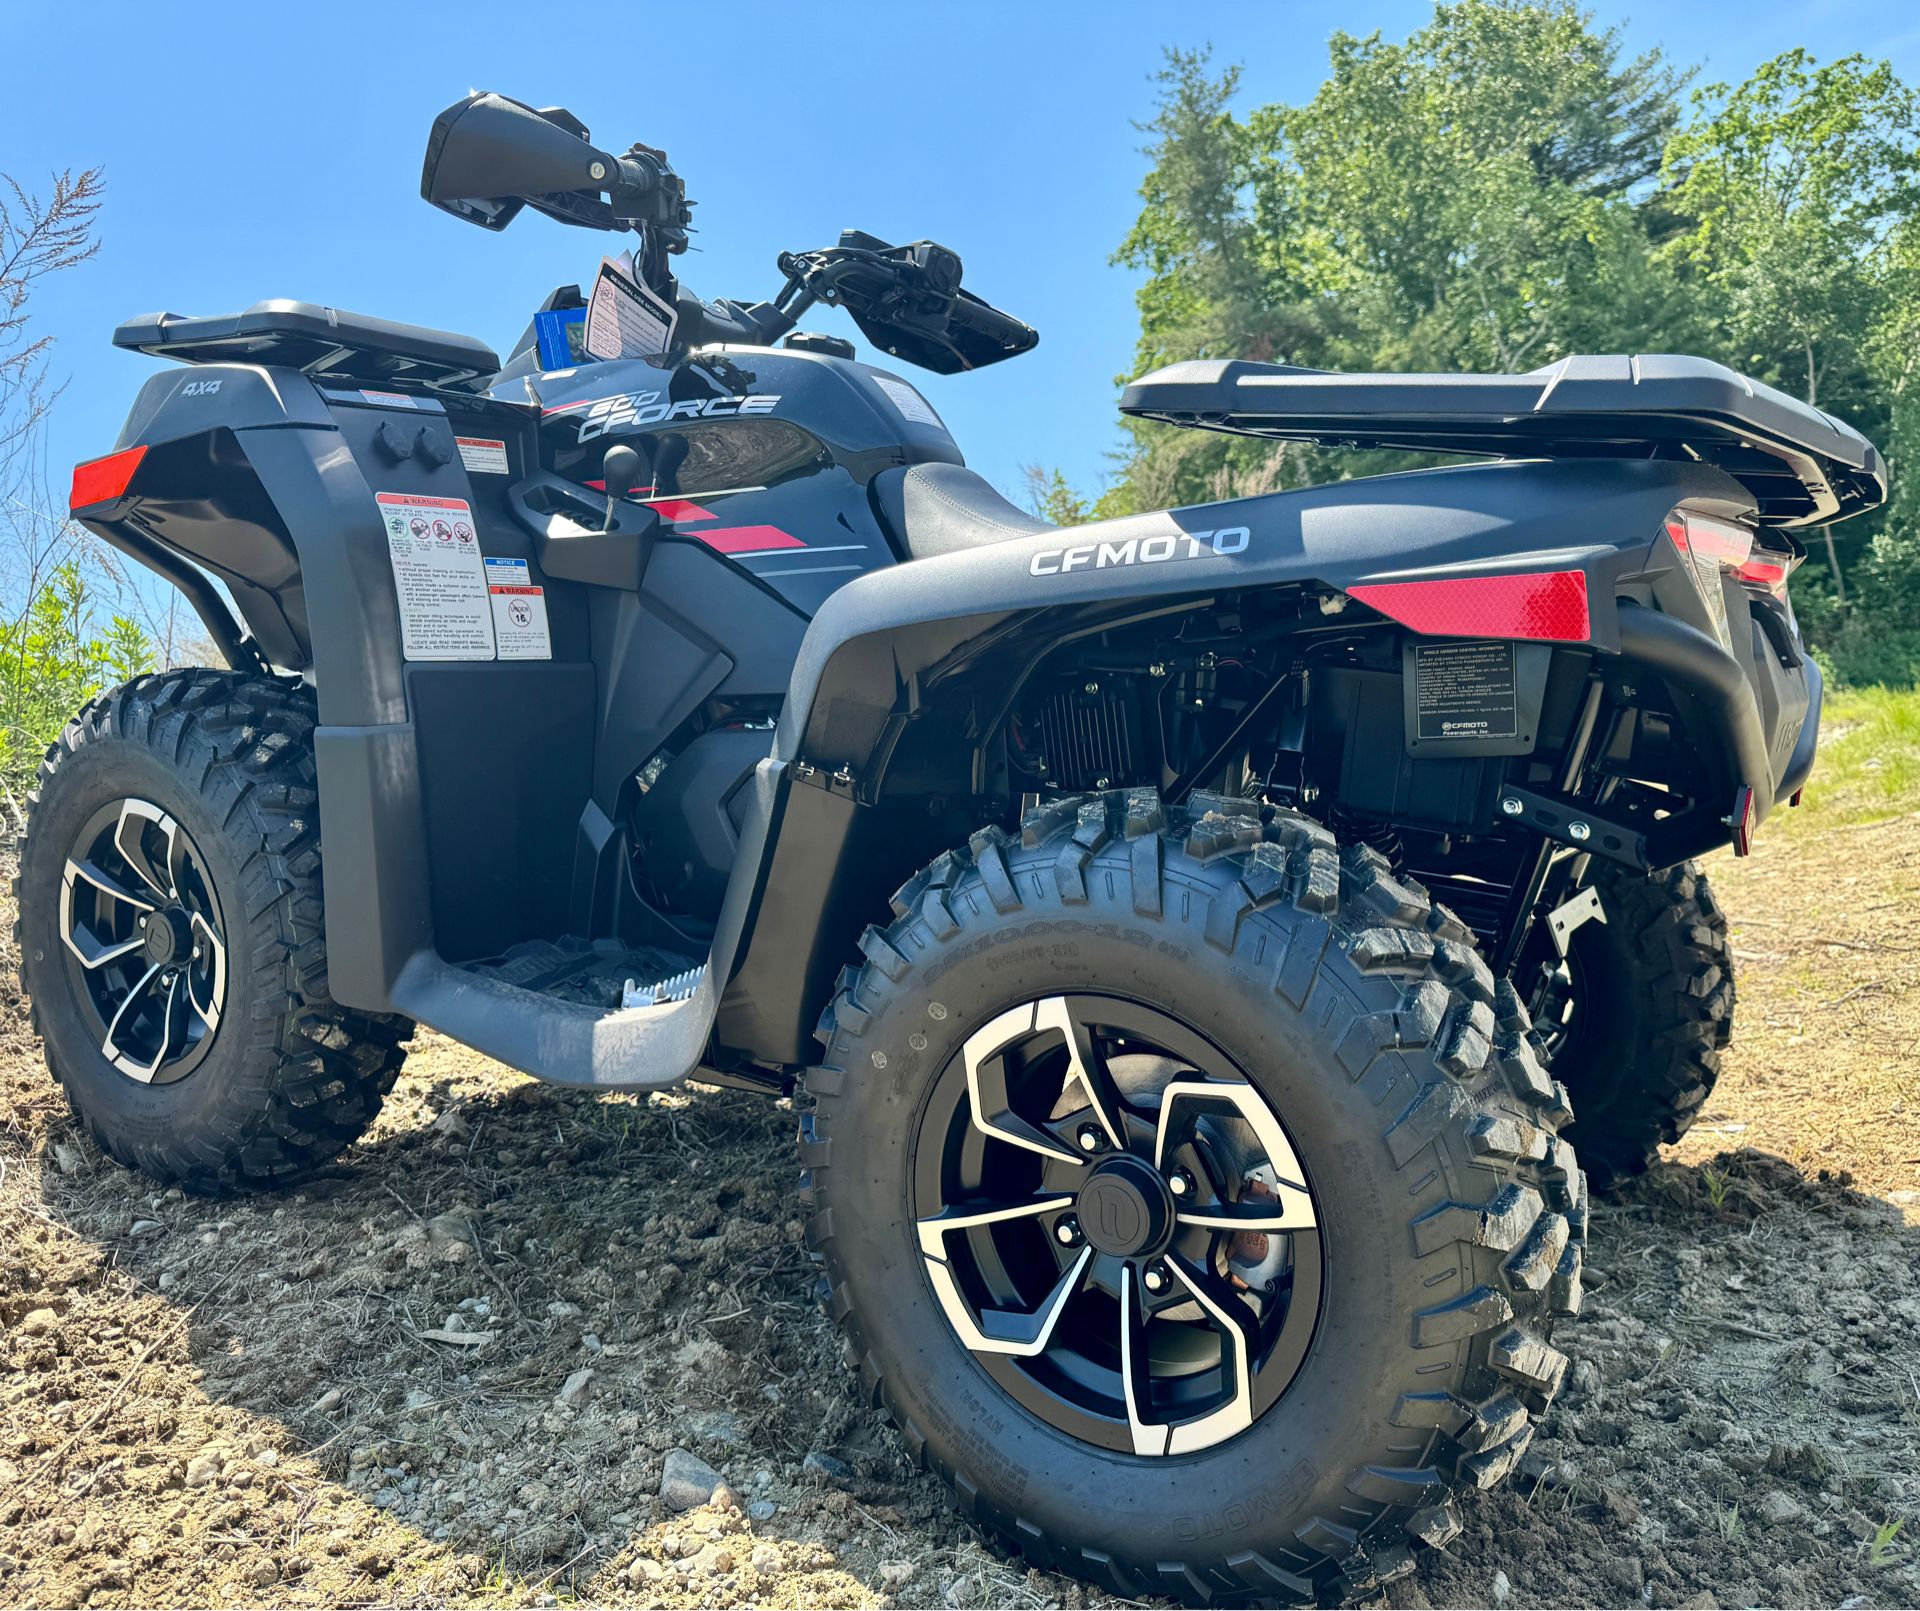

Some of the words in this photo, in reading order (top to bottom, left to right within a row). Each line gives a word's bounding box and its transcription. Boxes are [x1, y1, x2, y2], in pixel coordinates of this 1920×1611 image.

[611, 275, 634, 296] GENERAL
[634, 294, 645, 306] USE
[644, 302, 663, 320] MODEL
[578, 395, 782, 444] CFORCE
[588, 391, 661, 417] 600
[1030, 527, 1249, 576] CFMOTO
[515, 615, 526, 623] 16
[960, 1388, 1004, 1438] NYLON
[1172, 1458, 1318, 1543] CFMOTO
